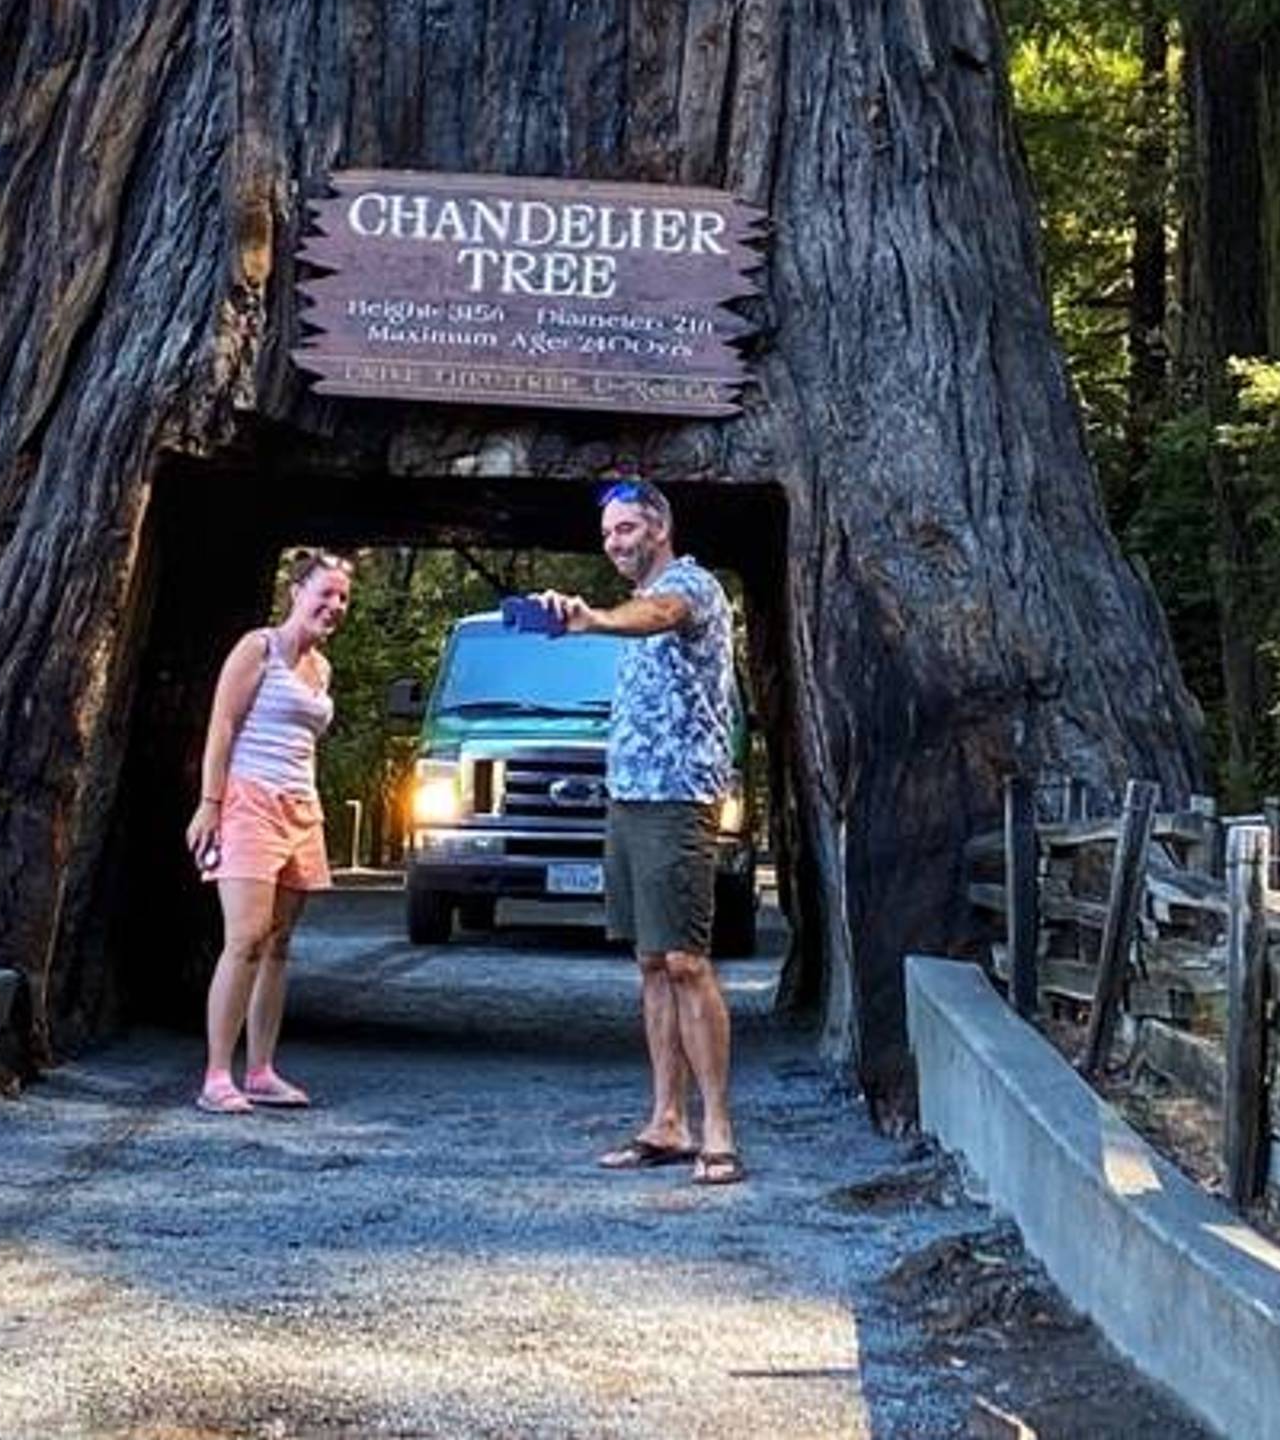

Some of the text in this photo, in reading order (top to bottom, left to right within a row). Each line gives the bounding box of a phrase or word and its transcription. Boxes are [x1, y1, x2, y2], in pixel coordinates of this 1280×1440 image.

[348, 194, 726, 253] CHANDELIER
[458, 250, 617, 298] TREE
[367, 326, 498, 346] Maximum
[510, 332, 568, 356] Age:
